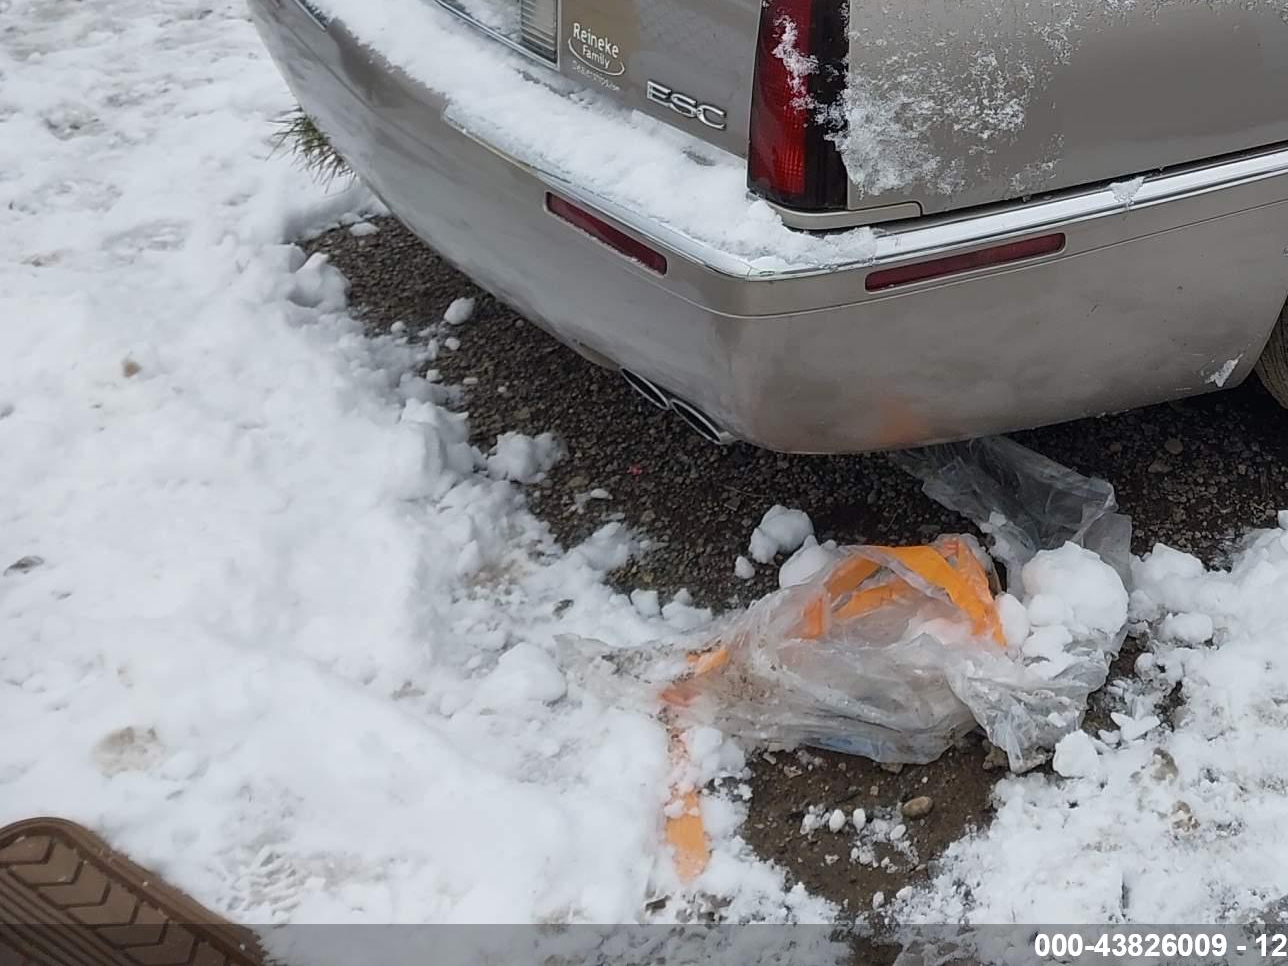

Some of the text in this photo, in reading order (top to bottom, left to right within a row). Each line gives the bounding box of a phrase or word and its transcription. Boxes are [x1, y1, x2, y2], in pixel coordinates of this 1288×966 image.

[573, 22, 619, 58] Reineke
[583, 44, 610, 69] Family
[646, 80, 726, 130] ESC
